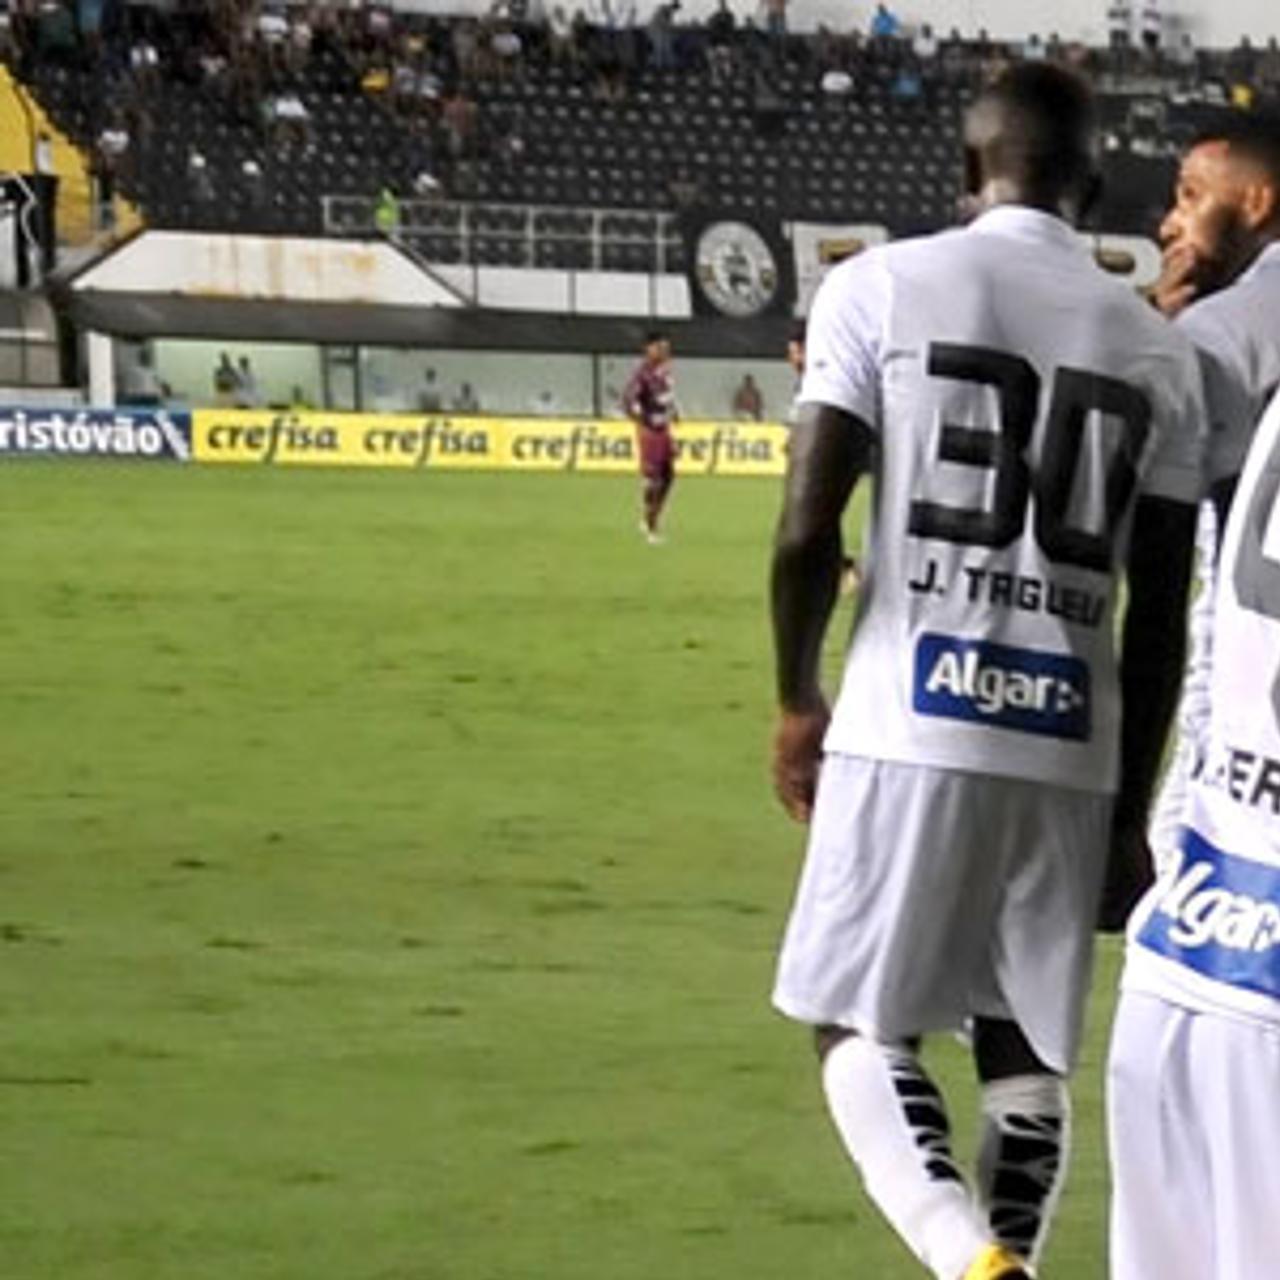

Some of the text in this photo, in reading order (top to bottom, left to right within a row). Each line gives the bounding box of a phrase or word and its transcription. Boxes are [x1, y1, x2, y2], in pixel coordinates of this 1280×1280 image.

[206, 415, 339, 464] crefisa
[363, 416, 488, 467] crefisa
[511, 424, 633, 470] crefisa
[678, 427, 775, 473] refisa
[907, 341, 1152, 573] 30
[908, 559, 945, 597] J.
[925, 650, 1062, 715] Algar
